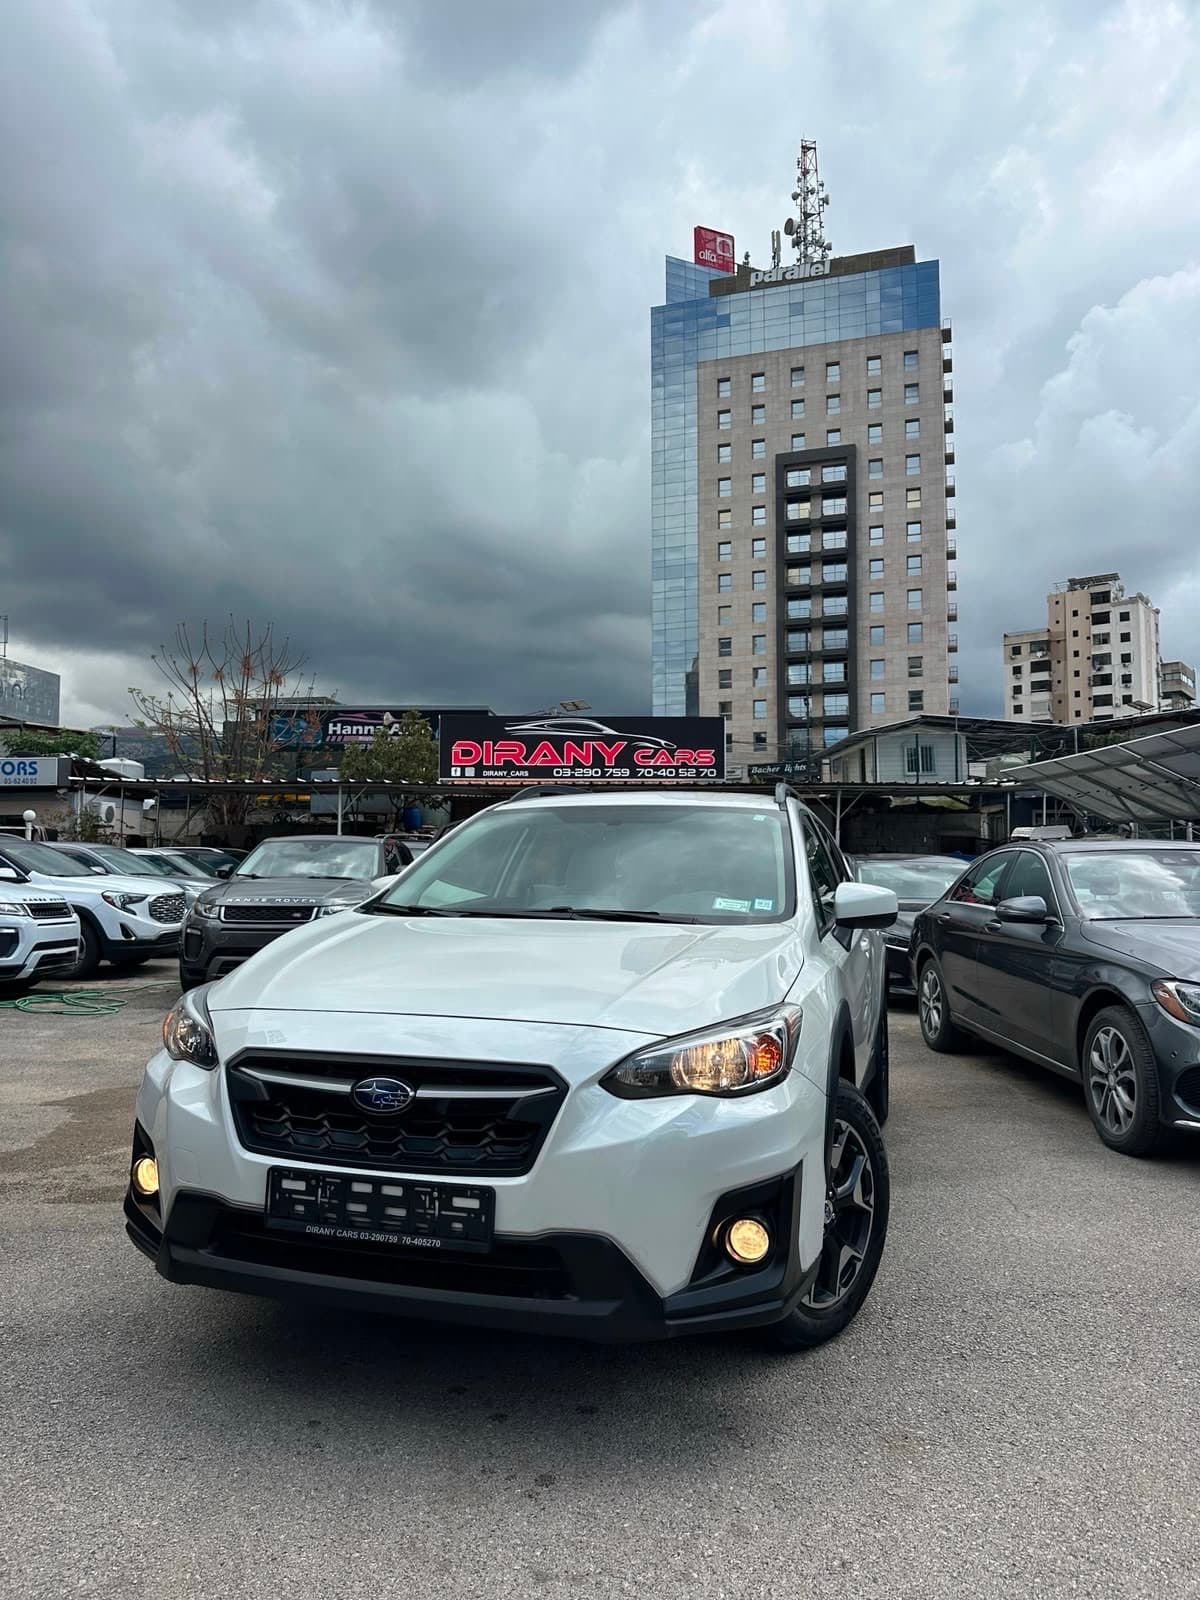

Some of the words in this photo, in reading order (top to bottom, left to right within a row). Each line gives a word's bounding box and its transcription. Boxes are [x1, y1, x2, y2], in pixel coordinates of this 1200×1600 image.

[699, 249, 717, 263] alfa
[749, 259, 831, 287] parallel
[451, 741, 628, 766] DIRANY
[633, 749, 716, 766] CARS
[0, 761, 38, 776] ORS
[482, 770, 529, 778] DIRANY_CARS
[553, 768, 602, 777] 03-290
[604, 768, 631, 777] 759
[636, 768, 676, 777] 70-40
[678, 768, 697, 777] 52
[699, 768, 717, 777] 70
[305, 1225, 336, 1236] DIRANY
[336, 1229, 359, 1239] CARS
[359, 1232, 398, 1243] 03-290759
[401, 1236, 441, 1248] 70-405270
